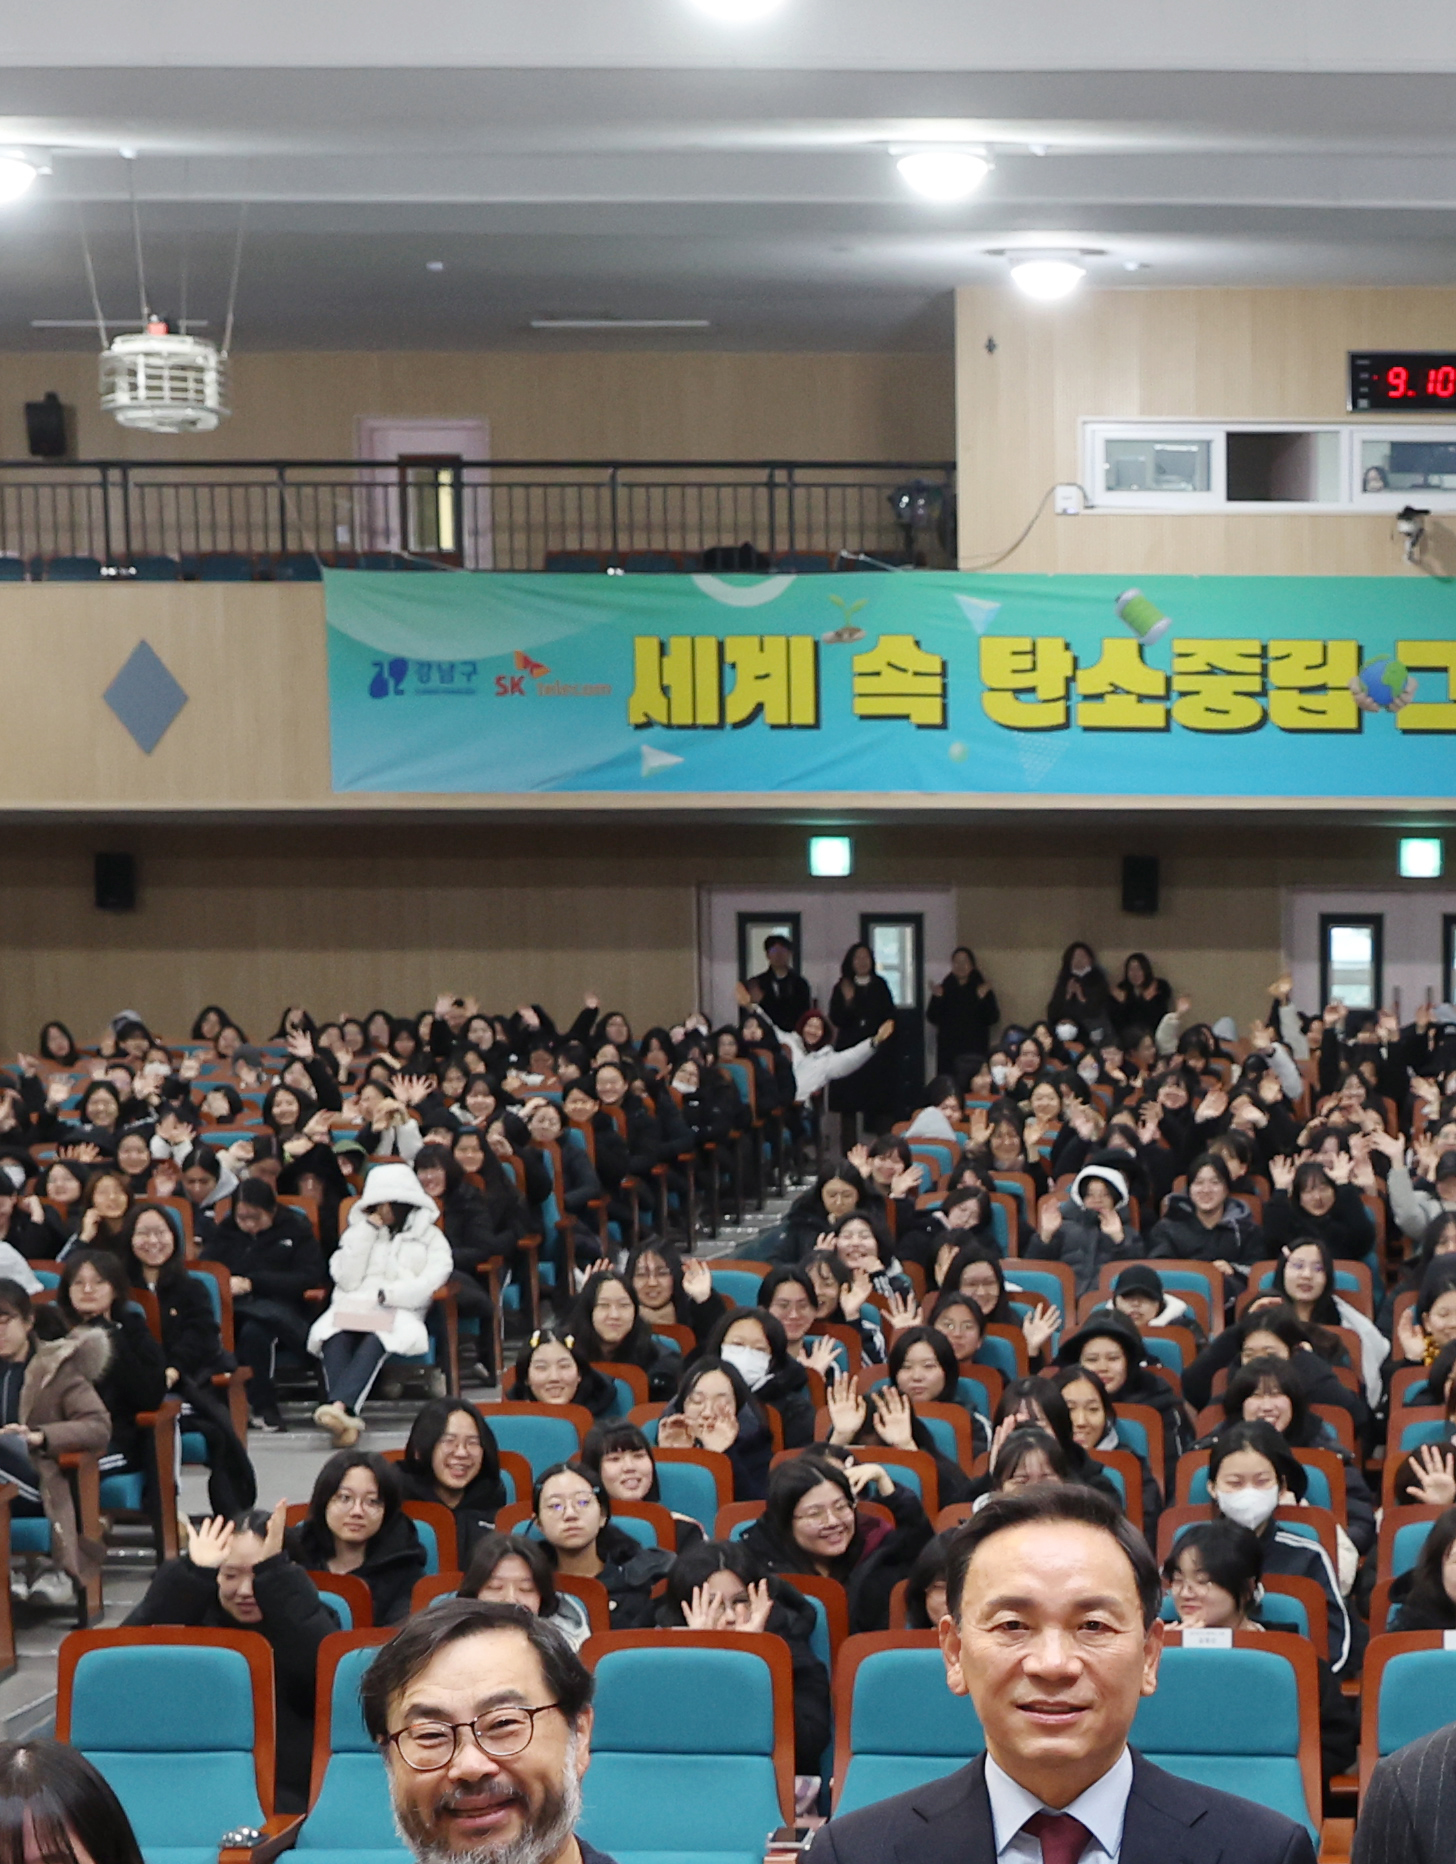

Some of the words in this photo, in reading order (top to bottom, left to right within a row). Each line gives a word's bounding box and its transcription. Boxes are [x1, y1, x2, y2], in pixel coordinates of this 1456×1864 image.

[496, 675, 526, 697] SK
[629, 636, 821, 730] 세계
[853, 636, 948, 728] 속
[981, 637, 1364, 733] 탄소중립
